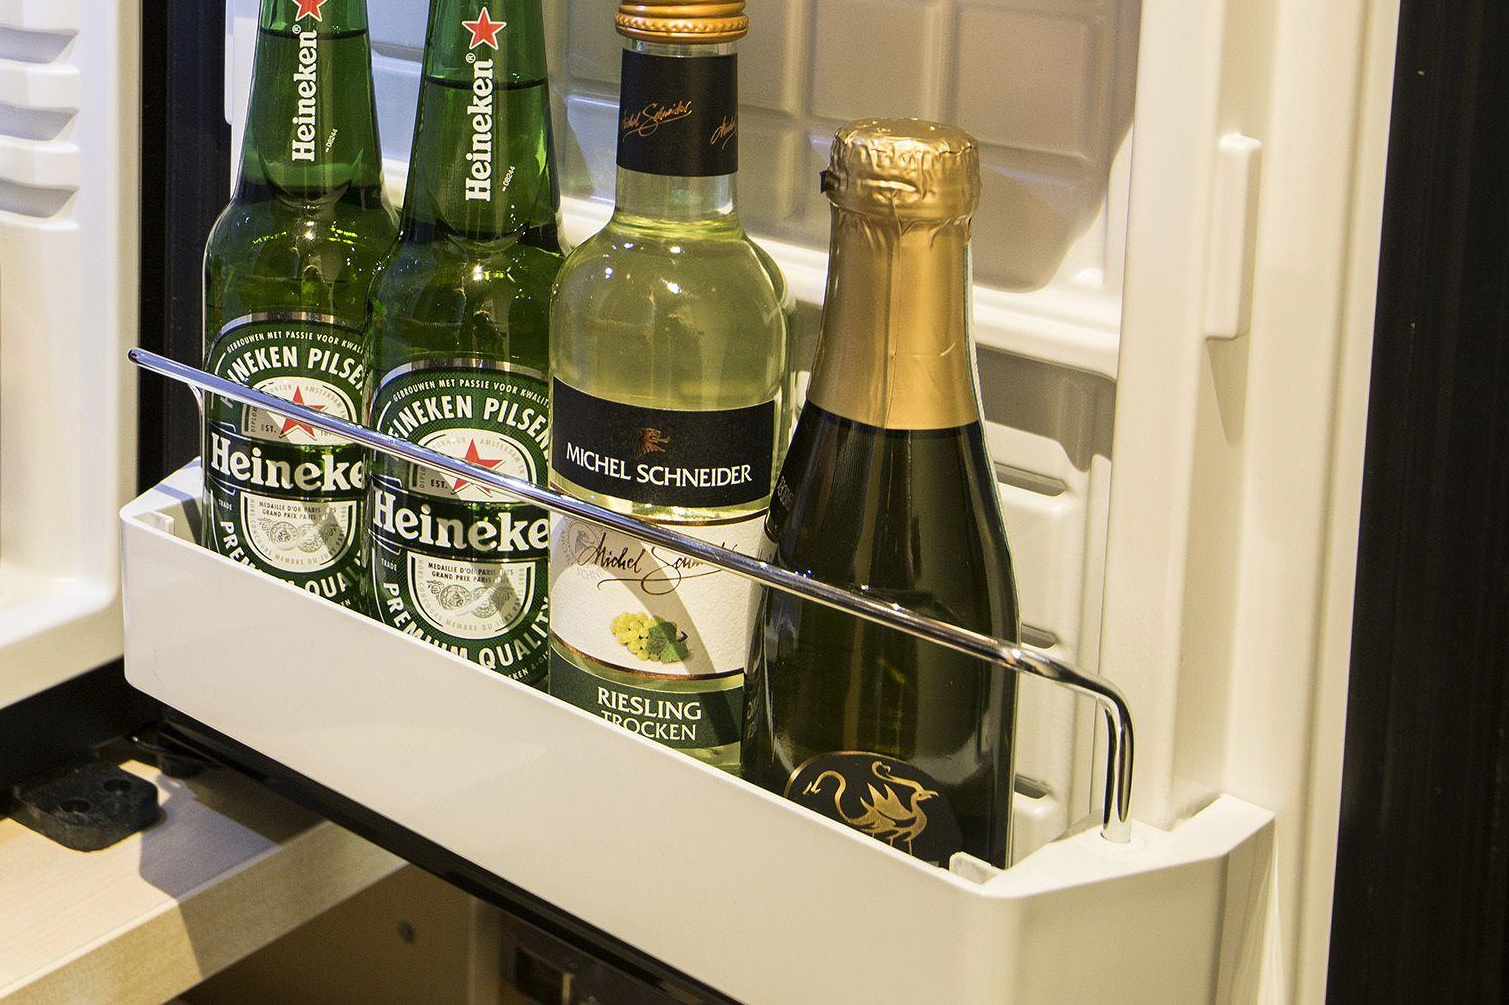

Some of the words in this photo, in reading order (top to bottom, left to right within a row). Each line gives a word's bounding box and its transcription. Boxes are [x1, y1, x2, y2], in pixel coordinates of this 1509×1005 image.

[292, 28, 318, 162] Heineken
[466, 58, 494, 202] Heineken
[227, 332, 265, 354] GEBROUWEN
[267, 331, 283, 340] MET
[286, 331, 313, 341] PASSIE
[316, 333, 340, 345] VOOR
[393, 380, 436, 402] GEBROUWEN
[438, 378, 455, 388] MET
[459, 379, 489, 389] PASSIE
[493, 381, 518, 395] VOOR
[261, 423, 277, 434] EST.
[566, 441, 632, 481] MICHEL
[636, 463, 753, 488] SCHNEIDER
[430, 479, 448, 490] EST.
[258, 500, 286, 512] MEDAILLE
[261, 508, 282, 520] GRAND
[381, 558, 398, 572] TRADE
[428, 561, 458, 574] MEDAILLE
[431, 570, 454, 581] GRAND
[455, 574, 471, 582] PRIX
[473, 574, 493, 583] PARIS
[597, 686, 702, 721] RIESLING
